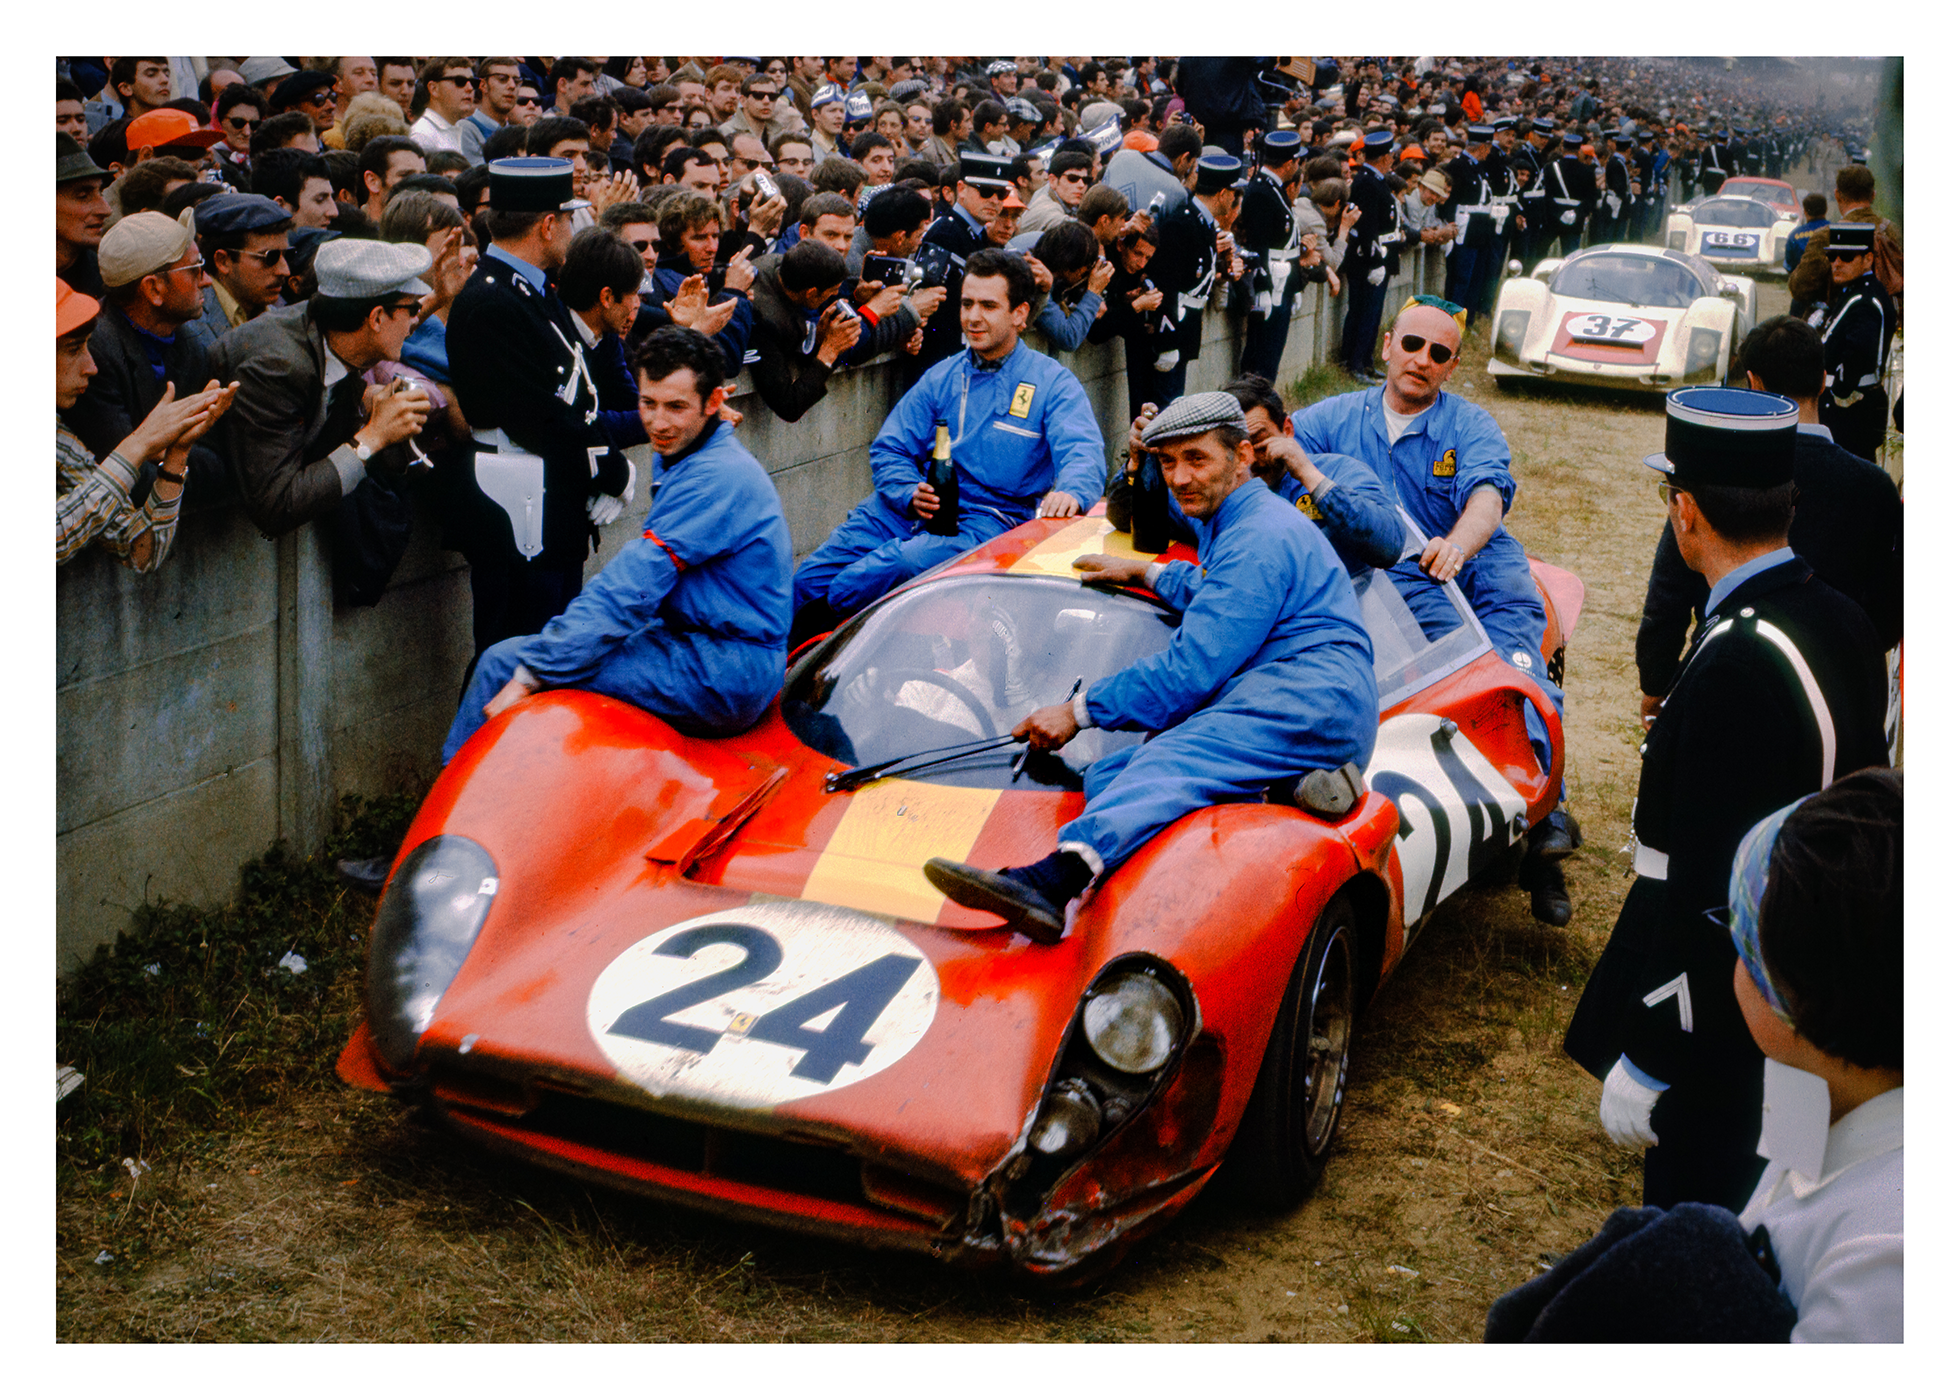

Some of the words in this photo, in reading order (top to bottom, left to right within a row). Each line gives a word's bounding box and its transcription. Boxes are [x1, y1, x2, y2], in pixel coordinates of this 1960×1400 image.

[1714, 231, 1748, 245] 66
[1583, 315, 1641, 338] 37
[604, 922, 925, 1086] 24
